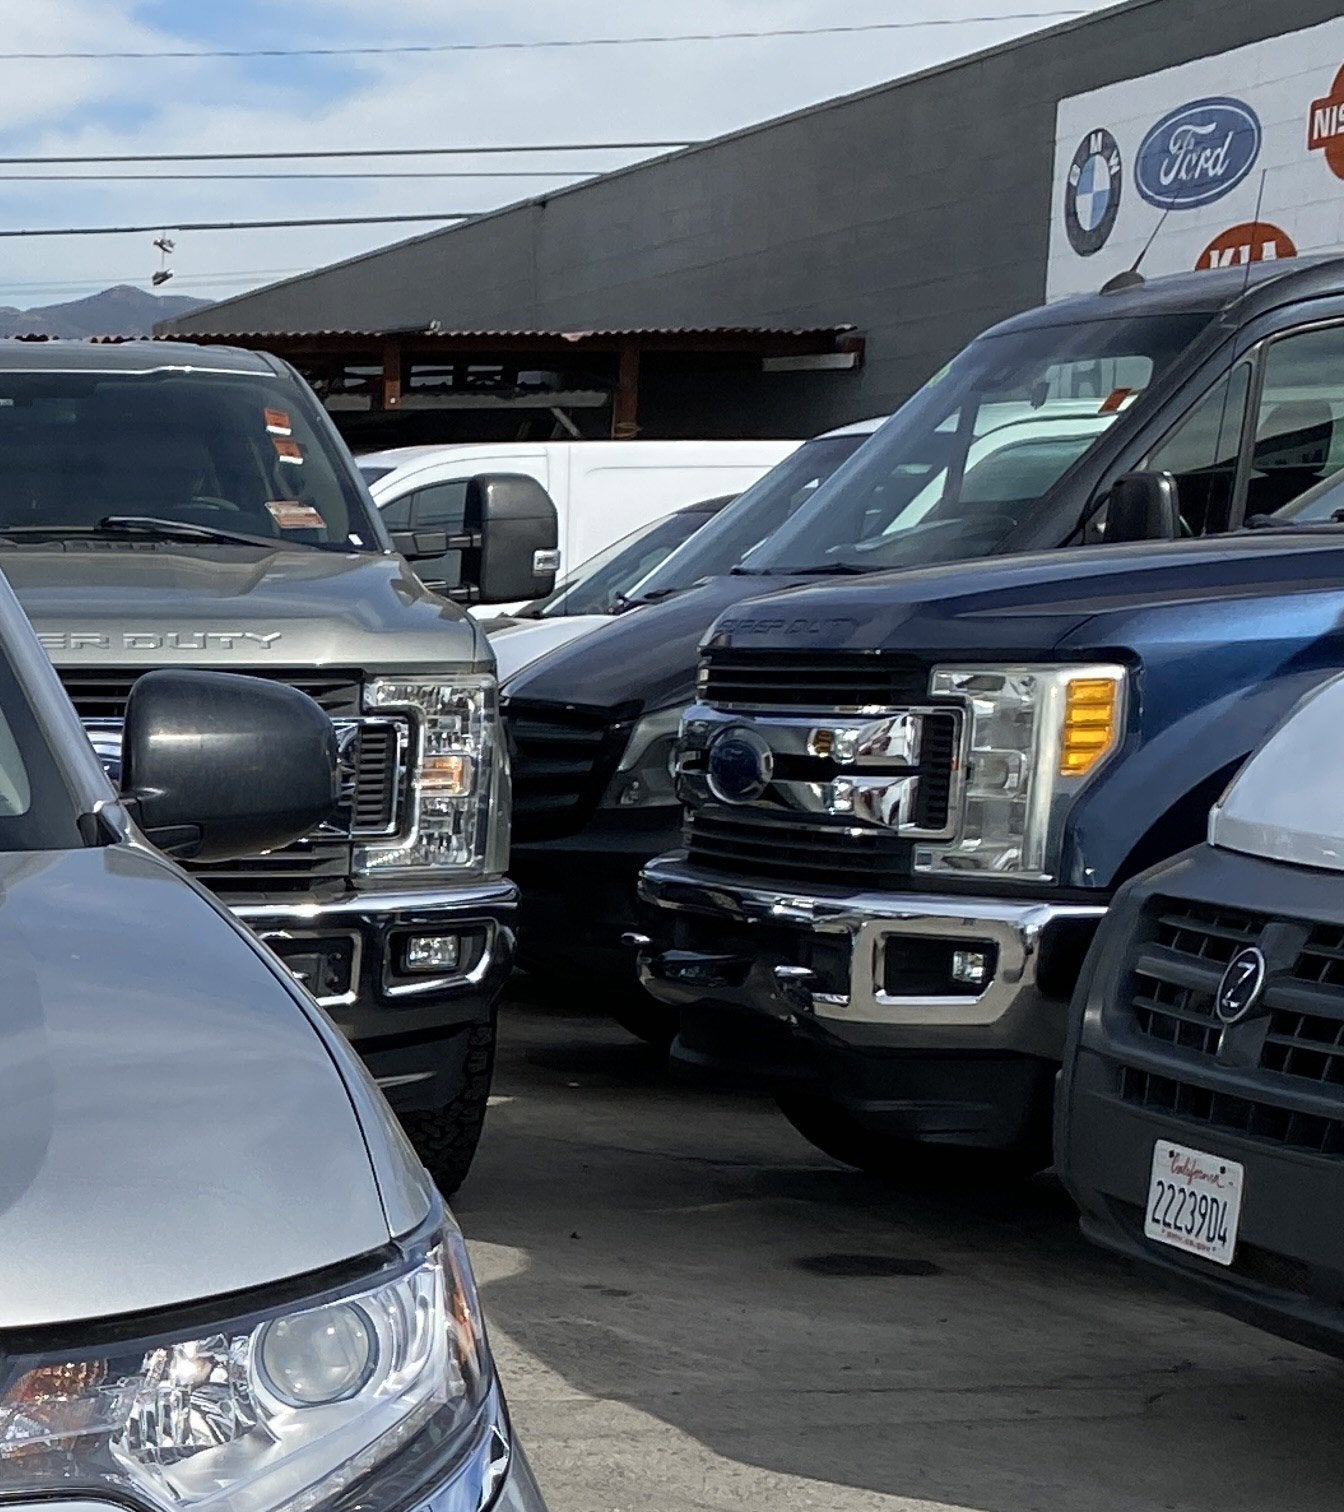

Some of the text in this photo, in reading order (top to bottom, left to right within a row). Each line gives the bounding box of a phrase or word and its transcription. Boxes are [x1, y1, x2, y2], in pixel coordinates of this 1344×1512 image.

[1069, 132, 1121, 186] BMW
[1160, 122, 1234, 186] Ford
[123, 632, 282, 650] DUTY
